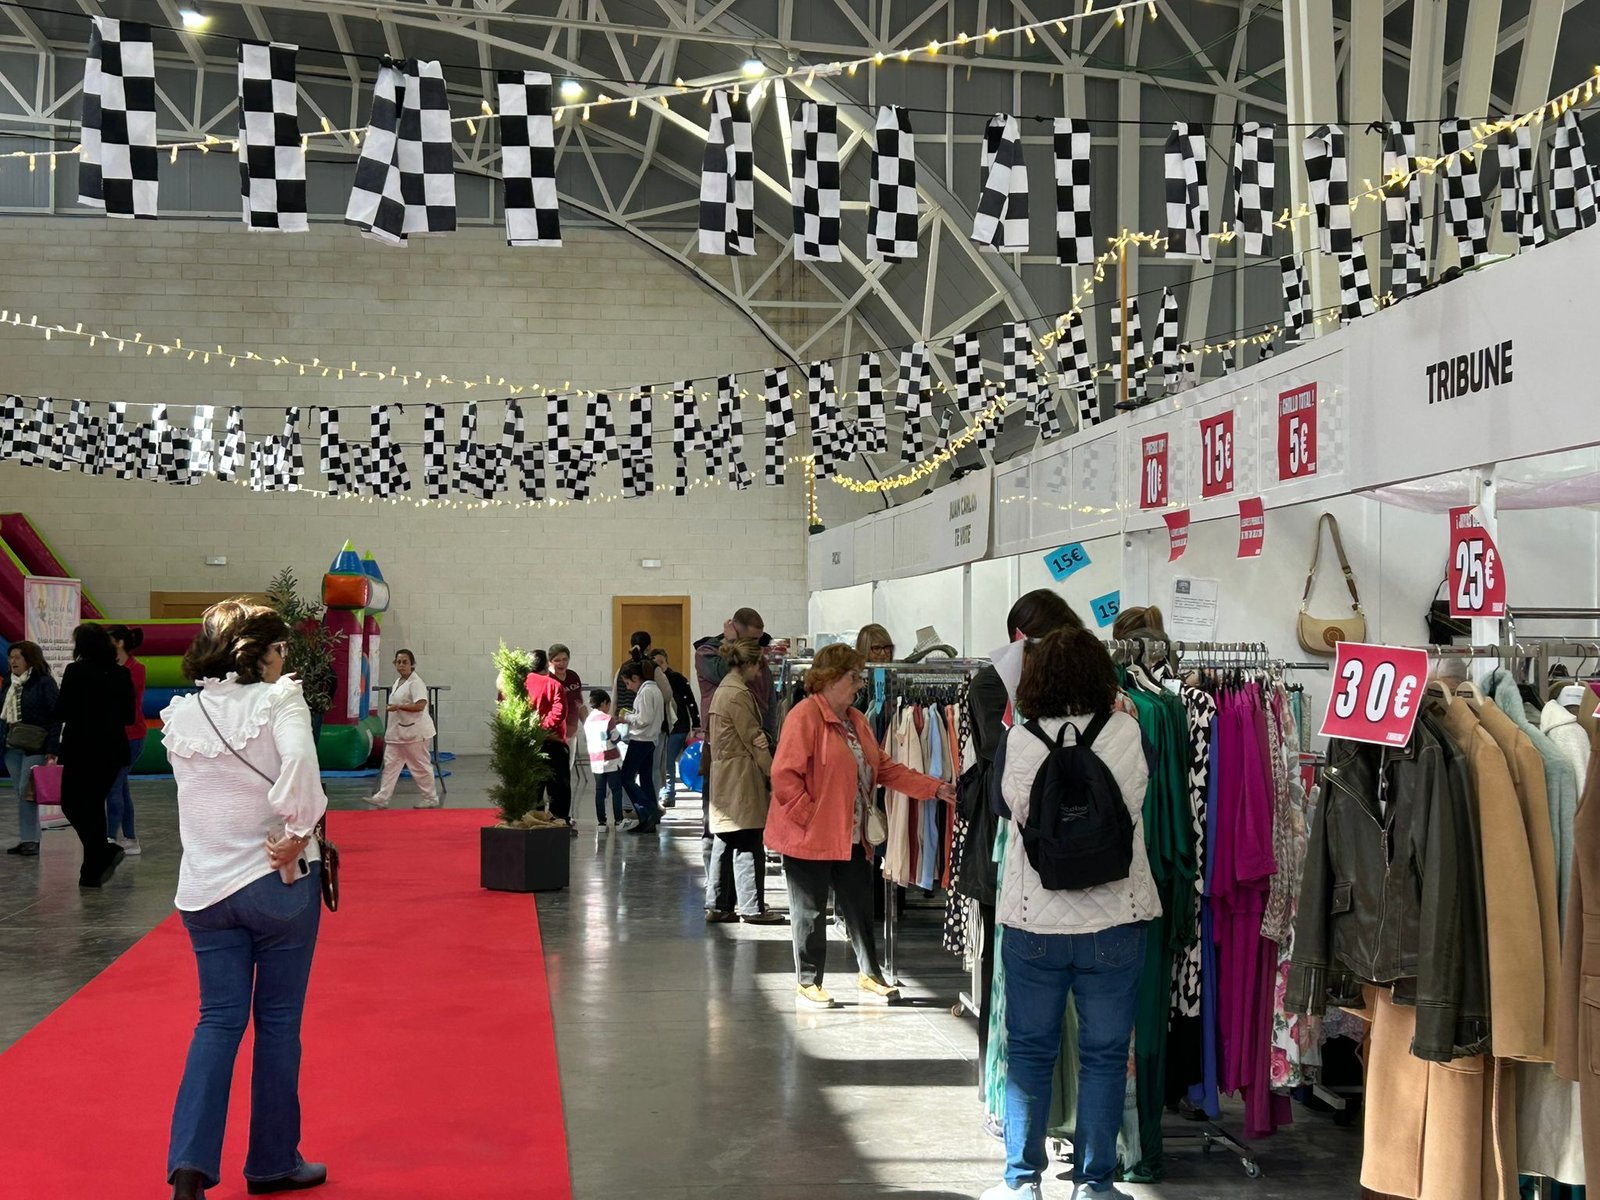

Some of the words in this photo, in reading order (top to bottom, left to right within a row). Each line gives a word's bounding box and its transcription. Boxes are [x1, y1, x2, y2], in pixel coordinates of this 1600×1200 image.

[1425, 339, 1513, 405] TRIBUNE
[1204, 423, 1232, 485] 15€
[1289, 417, 1309, 474] 5€
[1146, 458, 1163, 504] 10€
[1053, 547, 1084, 573] 15€
[1456, 541, 1495, 610] 25€
[1098, 600, 1120, 619] 15
[1335, 659, 1418, 723] 30€
